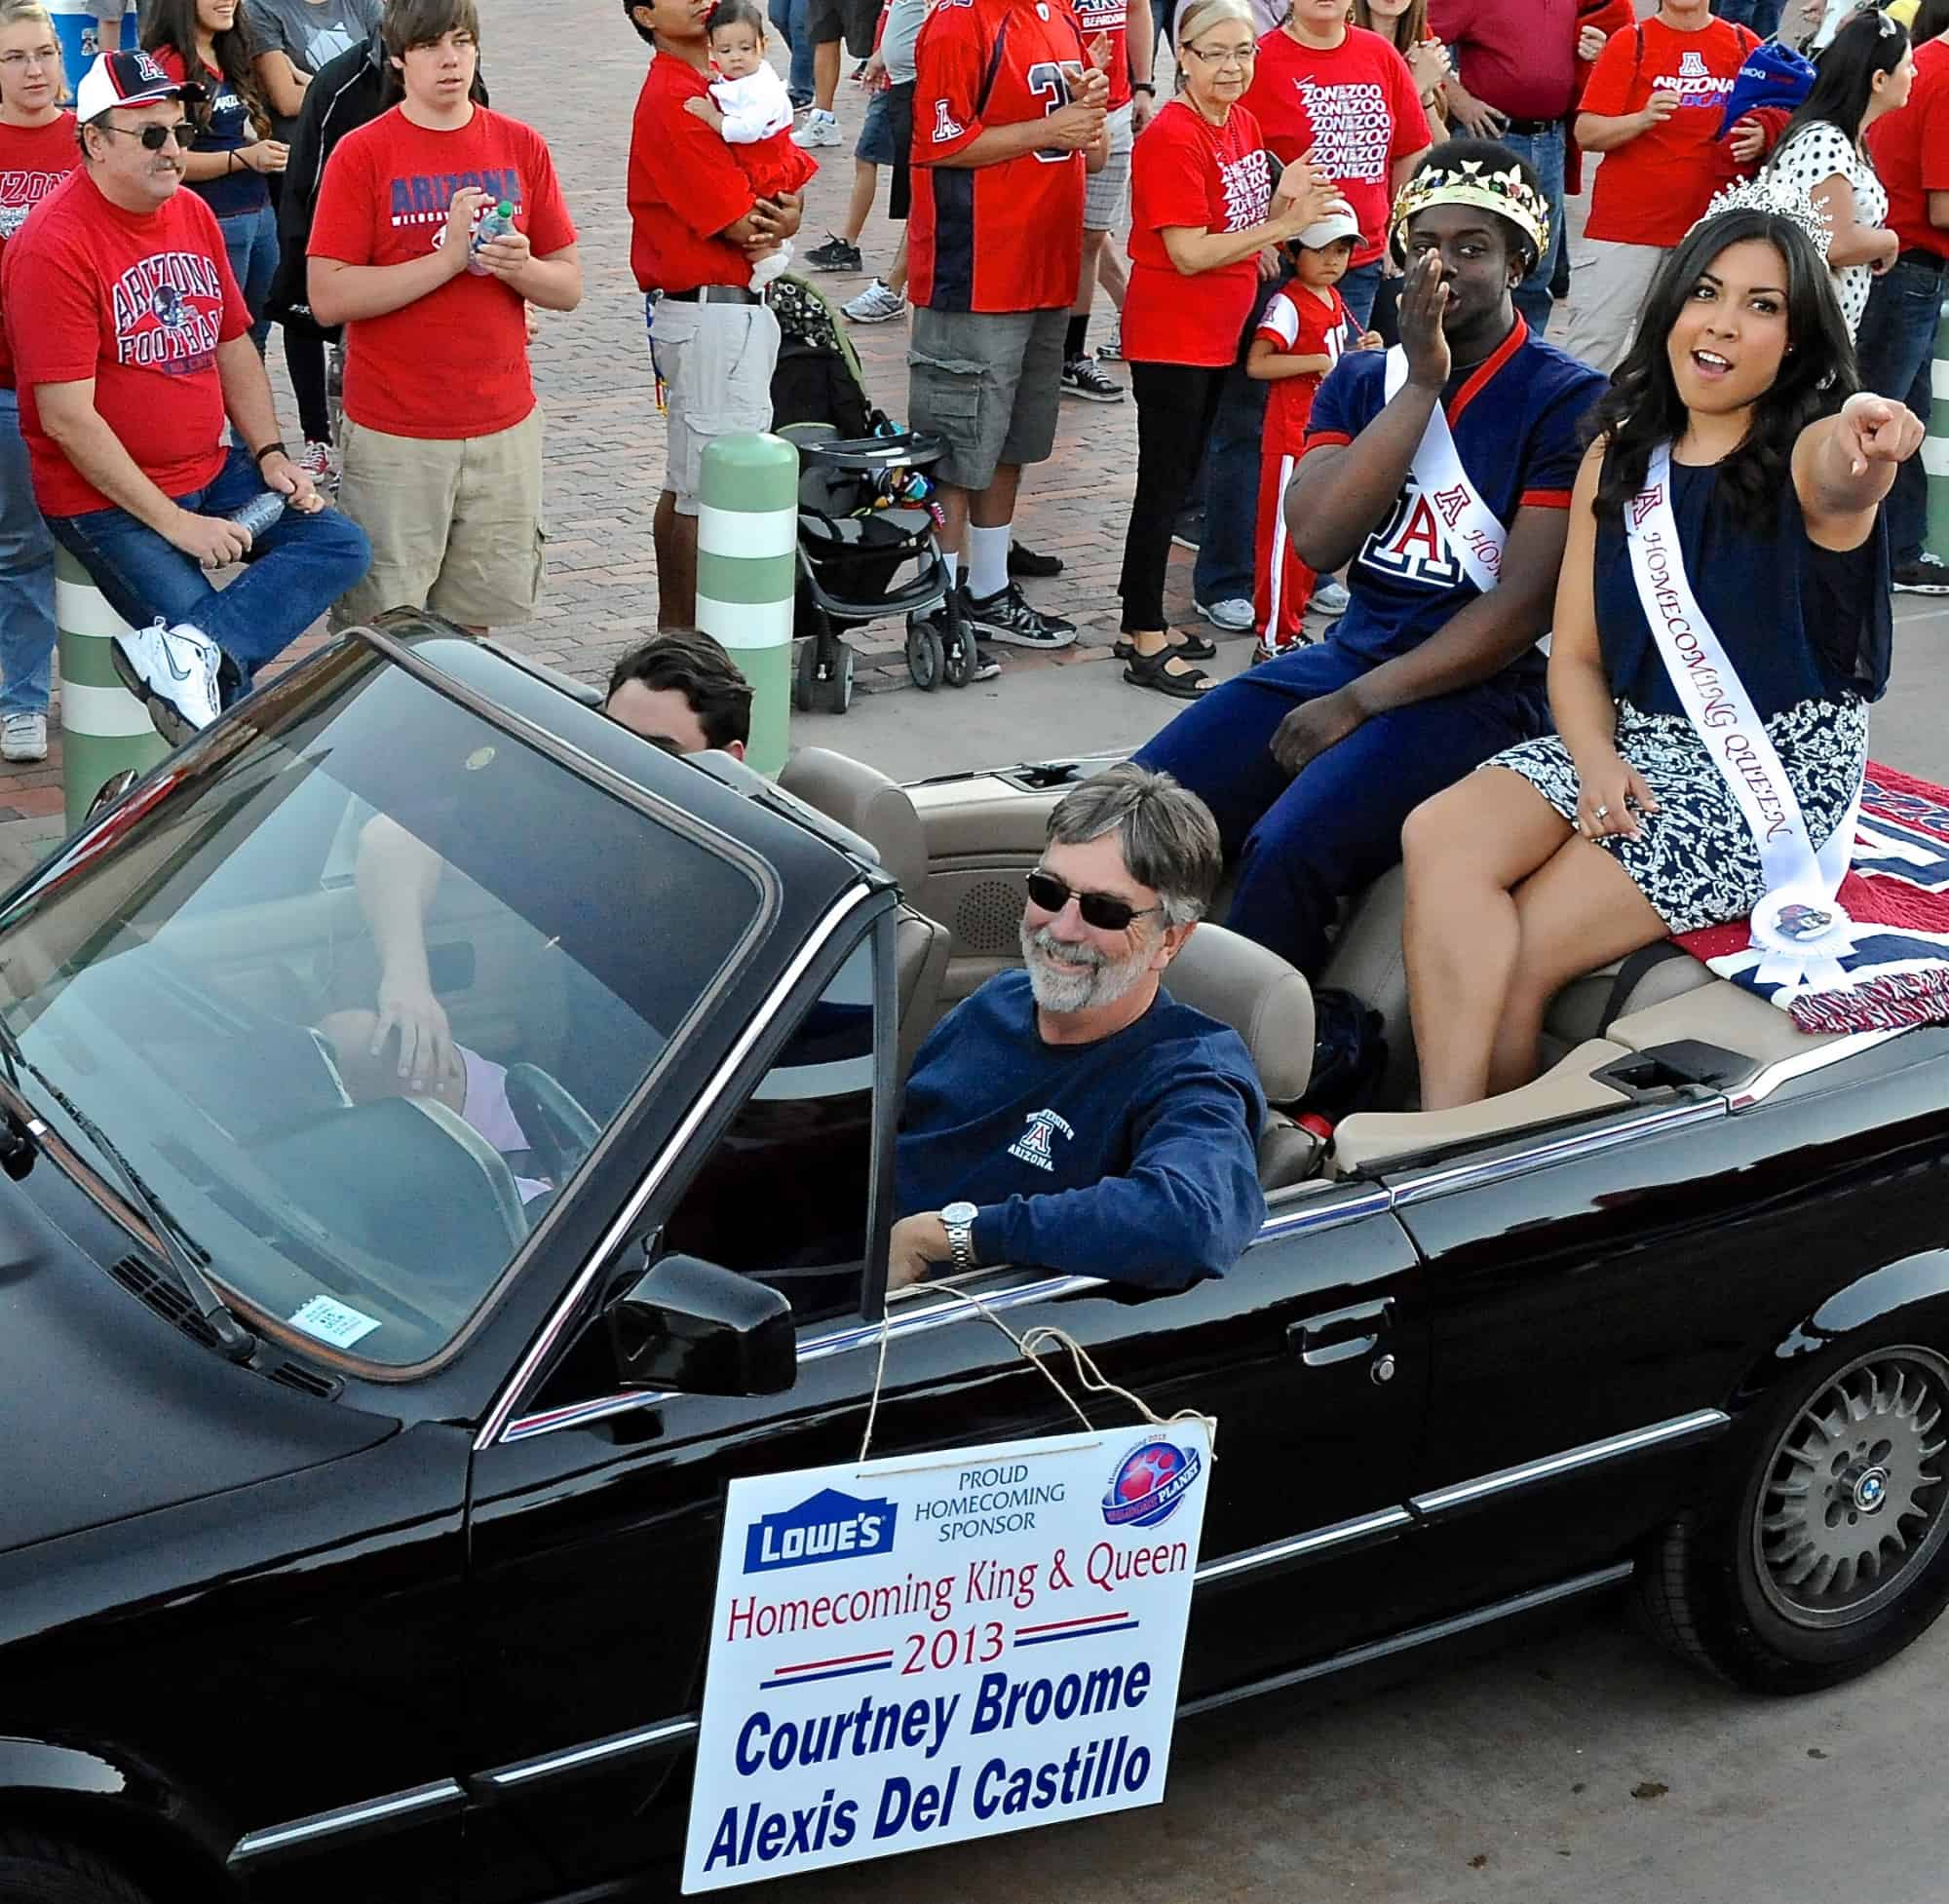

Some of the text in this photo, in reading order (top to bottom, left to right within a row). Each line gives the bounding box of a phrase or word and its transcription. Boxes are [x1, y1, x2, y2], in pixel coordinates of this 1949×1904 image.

[1653, 77, 1735, 94] ARIZONA
[1678, 53, 1709, 76] A
[933, 98, 966, 143] A
[112, 251, 223, 336] ARIZONA
[1358, 475, 1464, 588] A
[1643, 532, 1738, 728] HOMECOMING
[1724, 734, 1793, 844] QUEEN
[1007, 1143, 1054, 1171] ARIZONA
[915, 1483, 1066, 1521] HOMECOMING
[958, 1465, 1028, 1491] PROUD
[760, 1512, 883, 1563] LOWE'S
[938, 1511, 1037, 1542] SPONSOR
[726, 1542, 1188, 1642] Homecoming King & Queen
[900, 1620, 1004, 1676] 2013
[734, 1660, 1152, 1776] Courtney Broome
[703, 1735, 1152, 1873] Alexis Del Castillo
